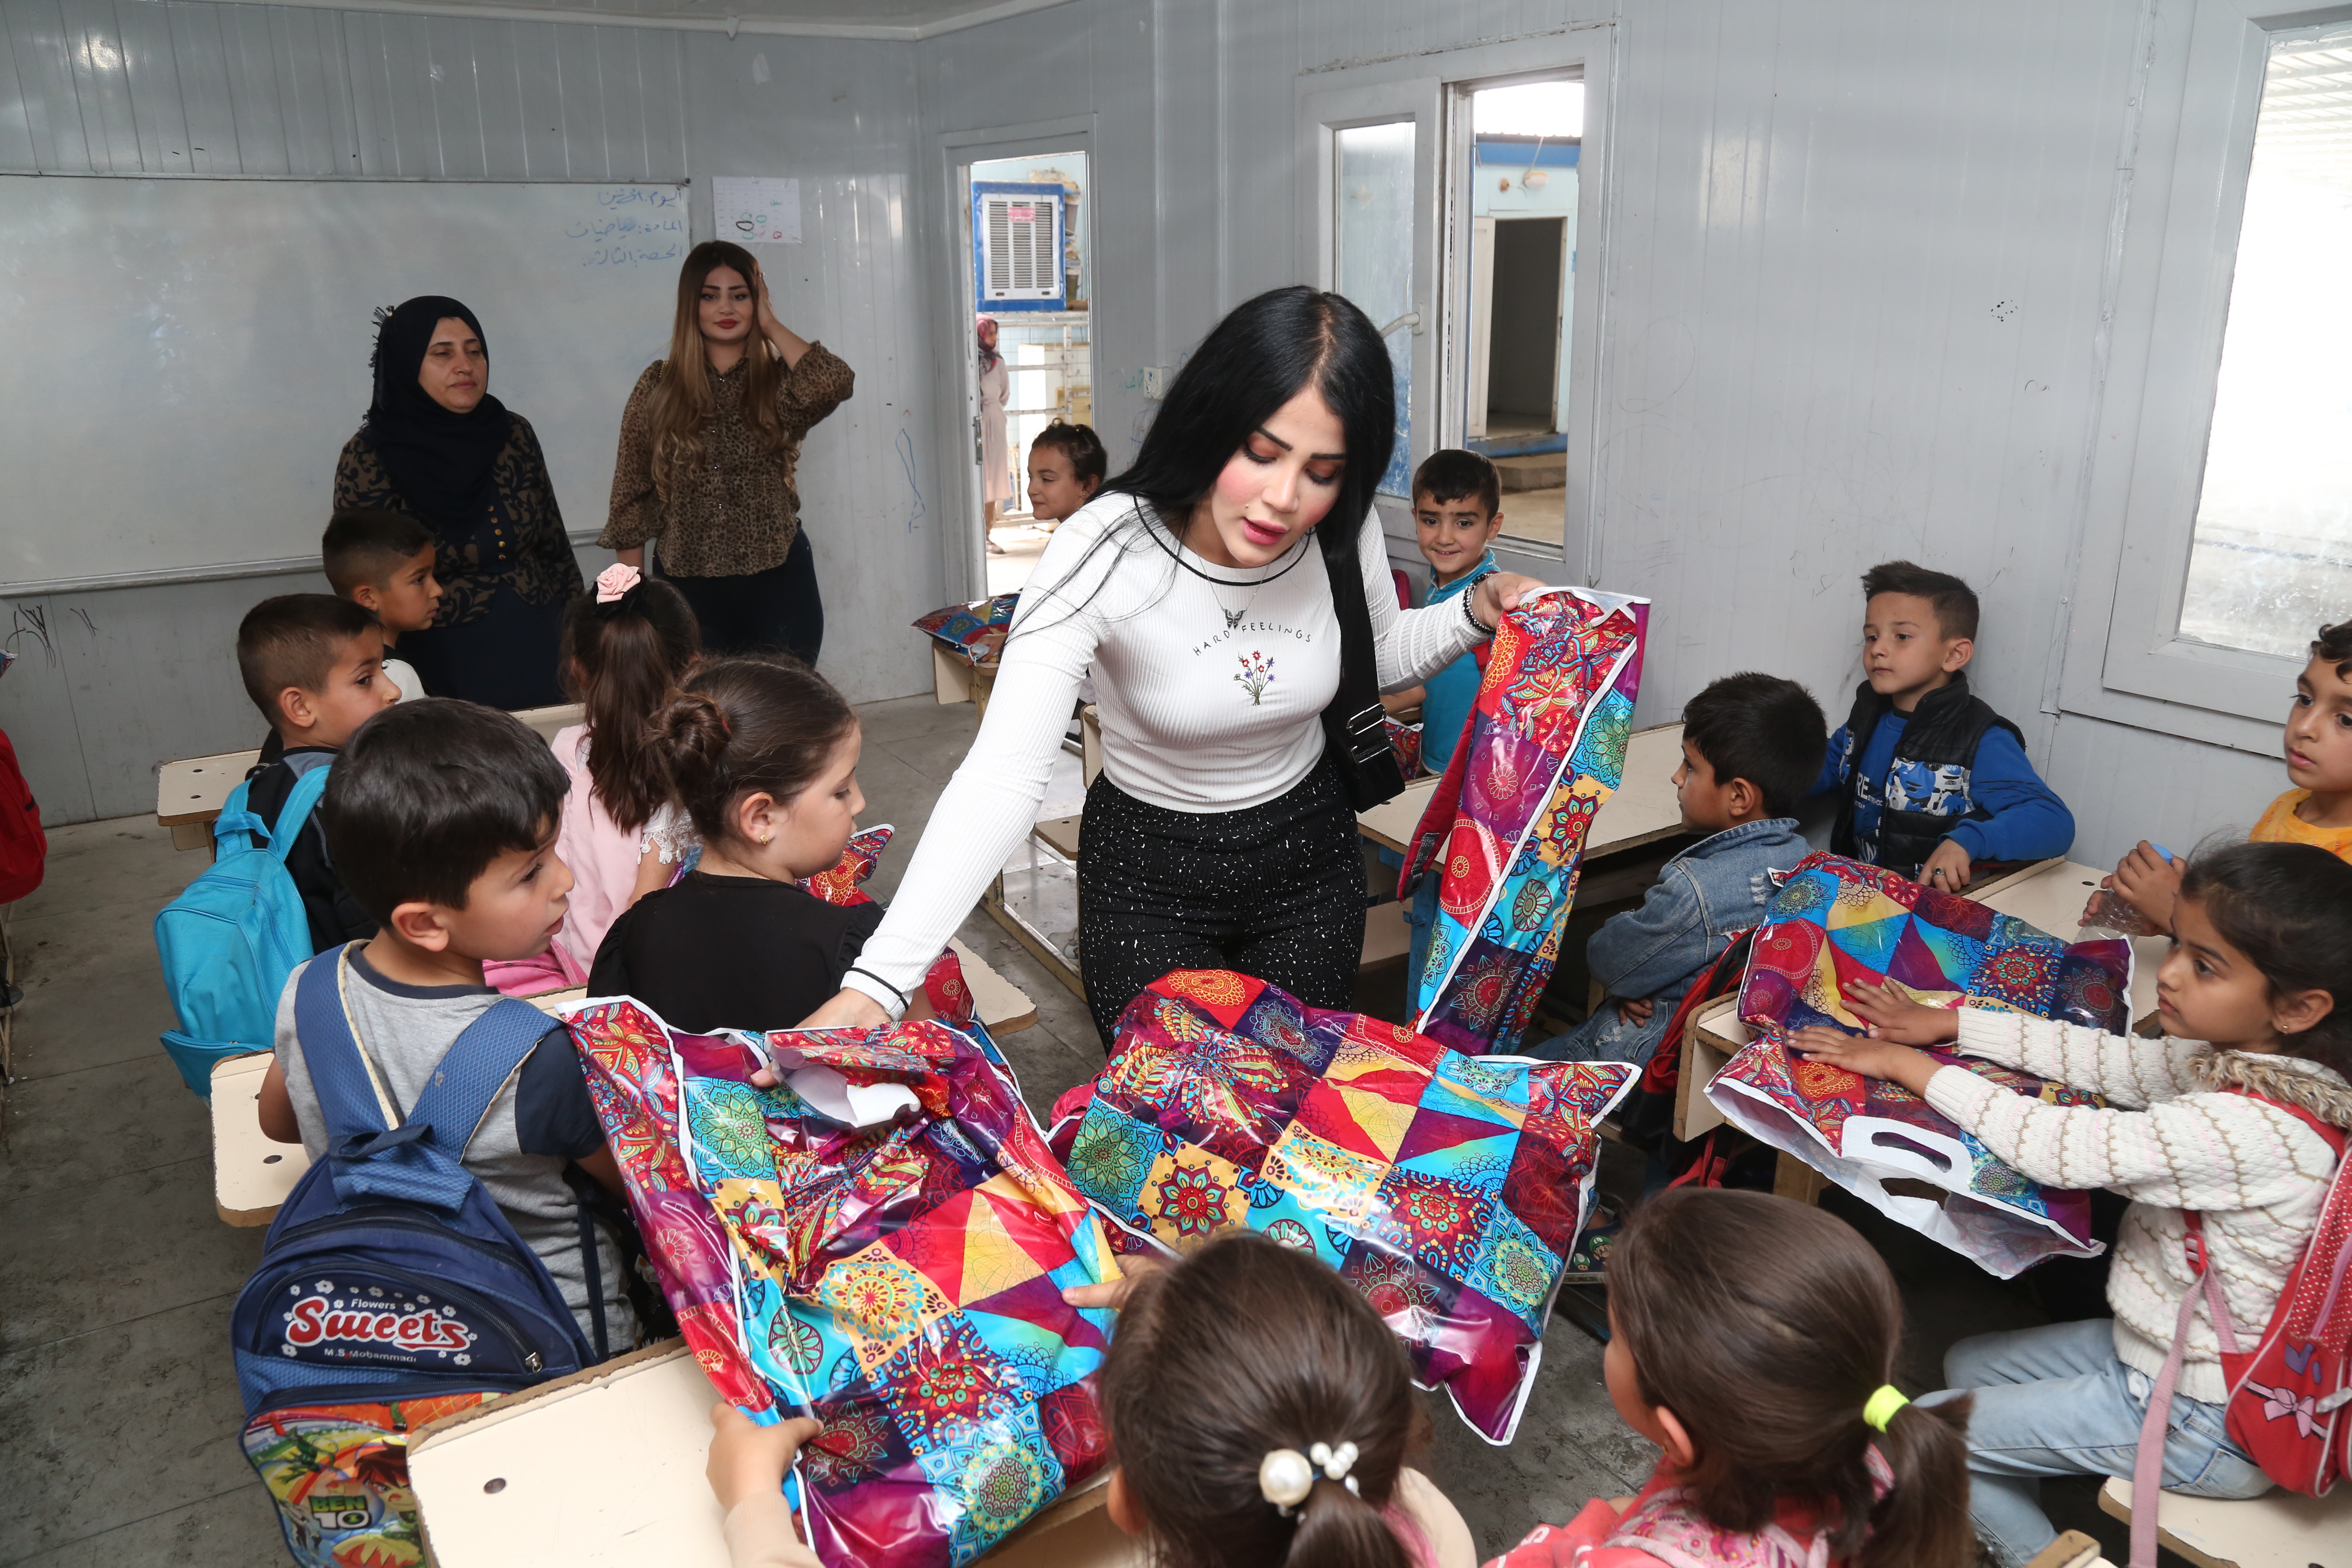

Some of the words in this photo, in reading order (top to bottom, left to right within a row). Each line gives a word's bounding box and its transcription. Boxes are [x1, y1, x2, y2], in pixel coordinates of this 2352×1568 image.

[1193, 630, 1230, 656] HARD
[1241, 622, 1311, 642] FEELINGS
[350, 1298, 396, 1310] Flowers
[287, 1296, 469, 1351] Sweets
[310, 1495, 367, 1512] BEN
[314, 1510, 370, 1528] 10
